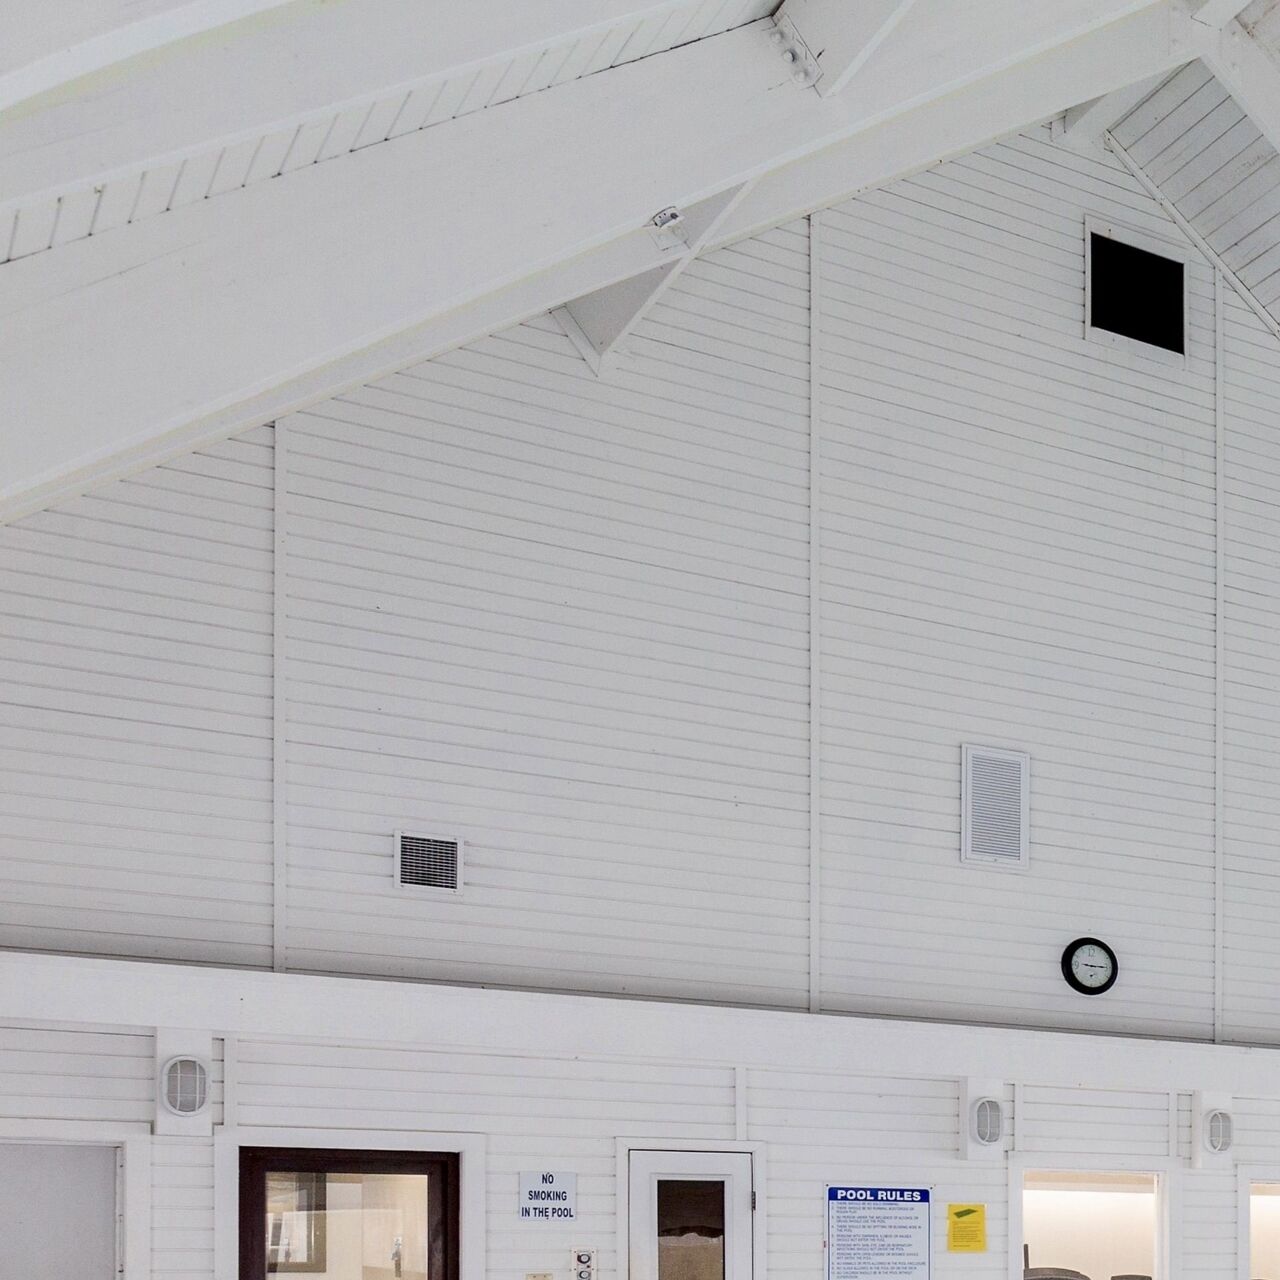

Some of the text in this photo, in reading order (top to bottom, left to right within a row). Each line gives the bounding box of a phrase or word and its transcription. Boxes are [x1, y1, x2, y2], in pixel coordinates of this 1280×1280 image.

[542, 1174, 554, 1184] NO
[528, 1190, 567, 1201] SMOKING
[837, 1189, 921, 1201] POOL RULES
[522, 1207, 574, 1217] IN THE POOL
